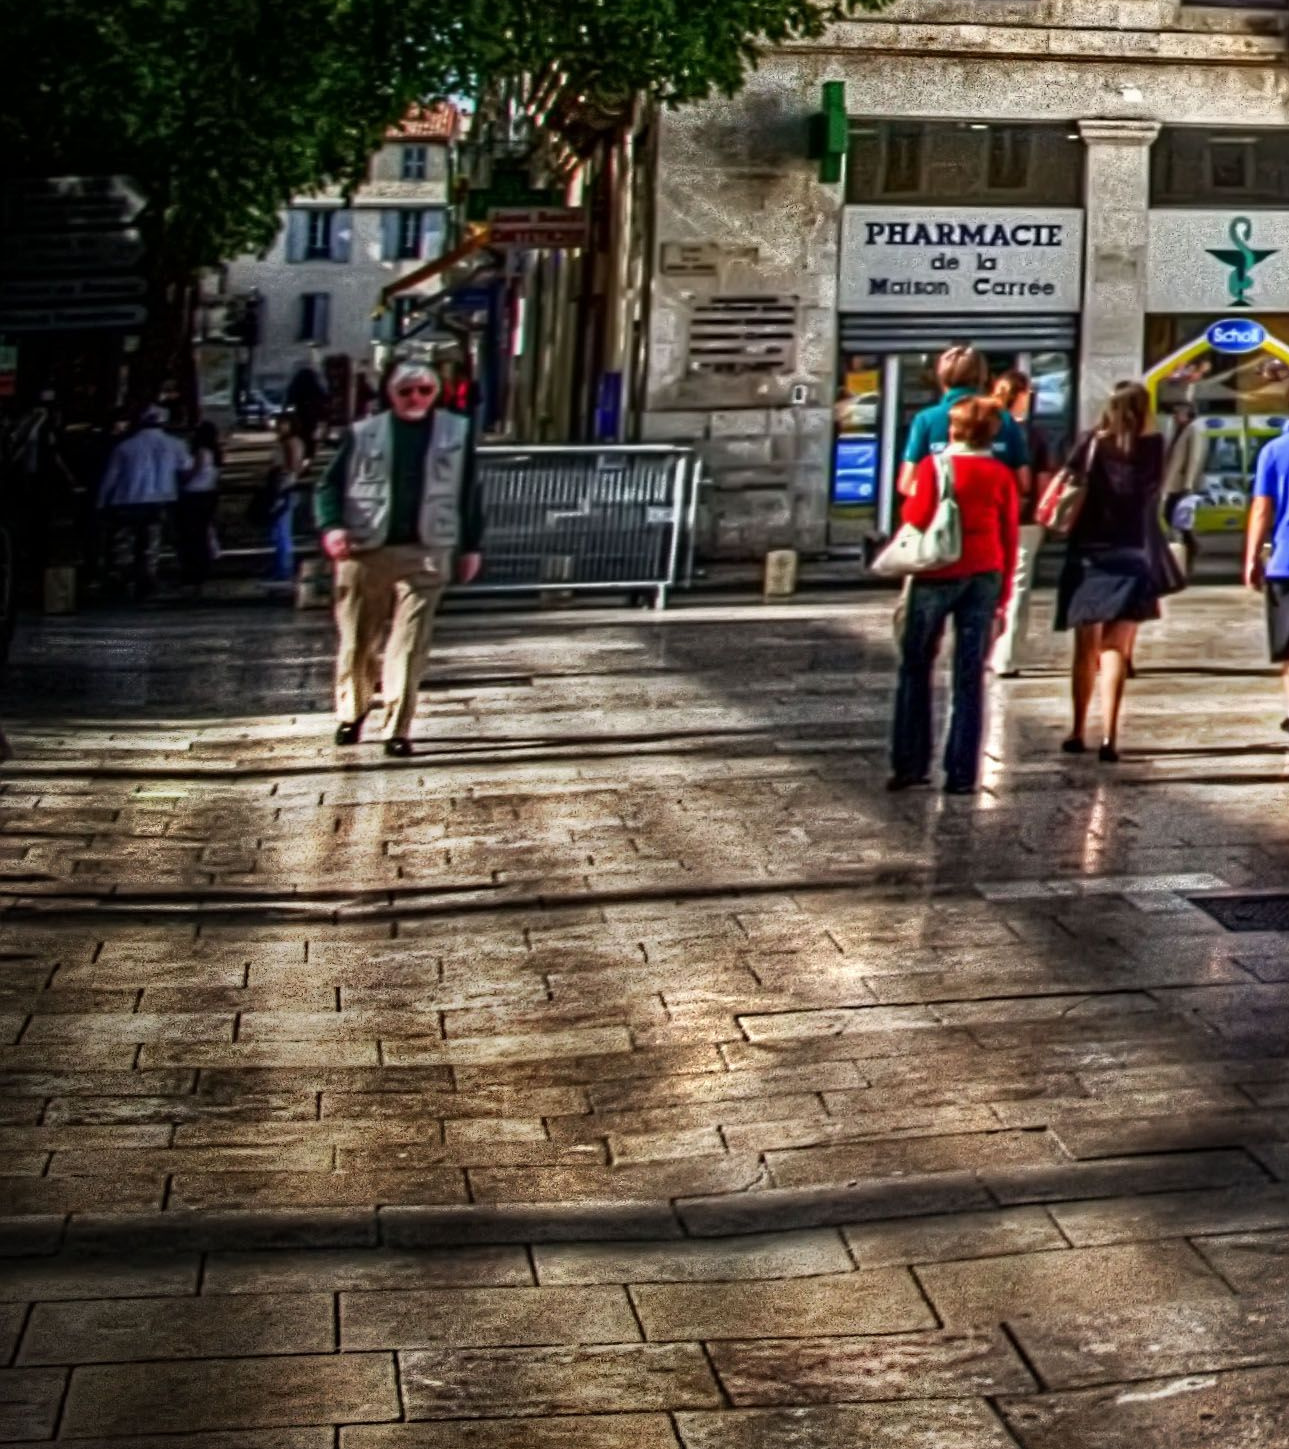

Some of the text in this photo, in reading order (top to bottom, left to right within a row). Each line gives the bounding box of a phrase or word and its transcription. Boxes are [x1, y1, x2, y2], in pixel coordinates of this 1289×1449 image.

[865, 222, 1062, 247] PHARMACIE
[930, 253, 997, 271] de la
[868, 277, 1055, 296] Maison Carrée
[1213, 326, 1260, 344] Scholl
